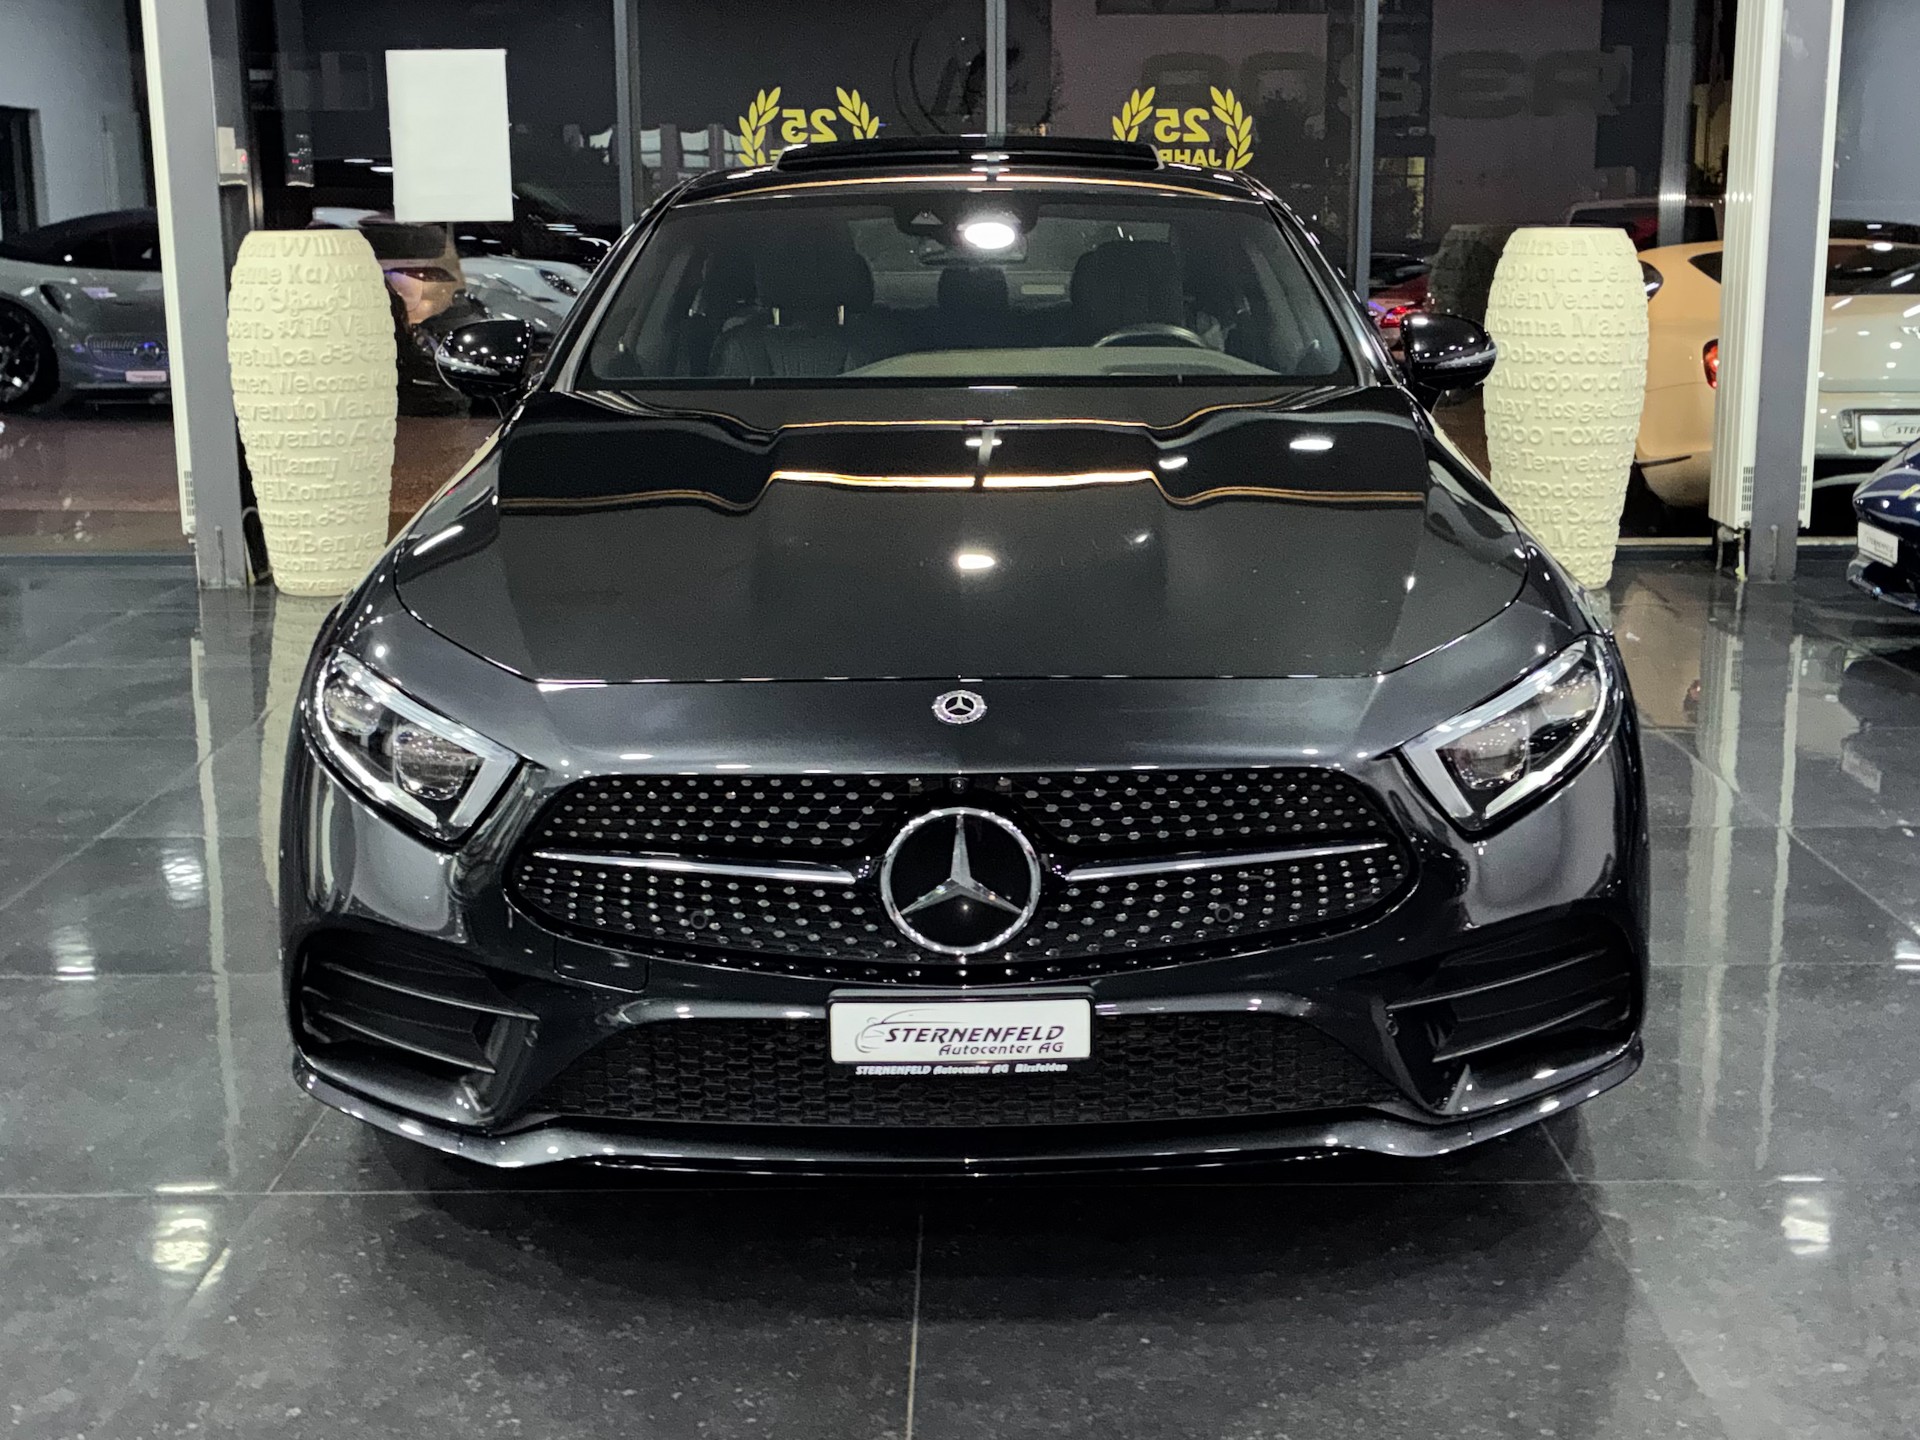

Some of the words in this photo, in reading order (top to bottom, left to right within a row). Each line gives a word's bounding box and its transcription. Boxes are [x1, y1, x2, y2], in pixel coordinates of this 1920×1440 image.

[885, 1026, 1064, 1044] STERNENFELD
[938, 1042, 1032, 1056] Autocenter
[1039, 1041, 1064, 1054] AG
[855, 1065, 931, 1076] STERNENFELD
[933, 1064, 990, 1075] Autocenter
[991, 1064, 1009, 1074] AG
[1014, 1063, 1068, 1073] Birsfelden
